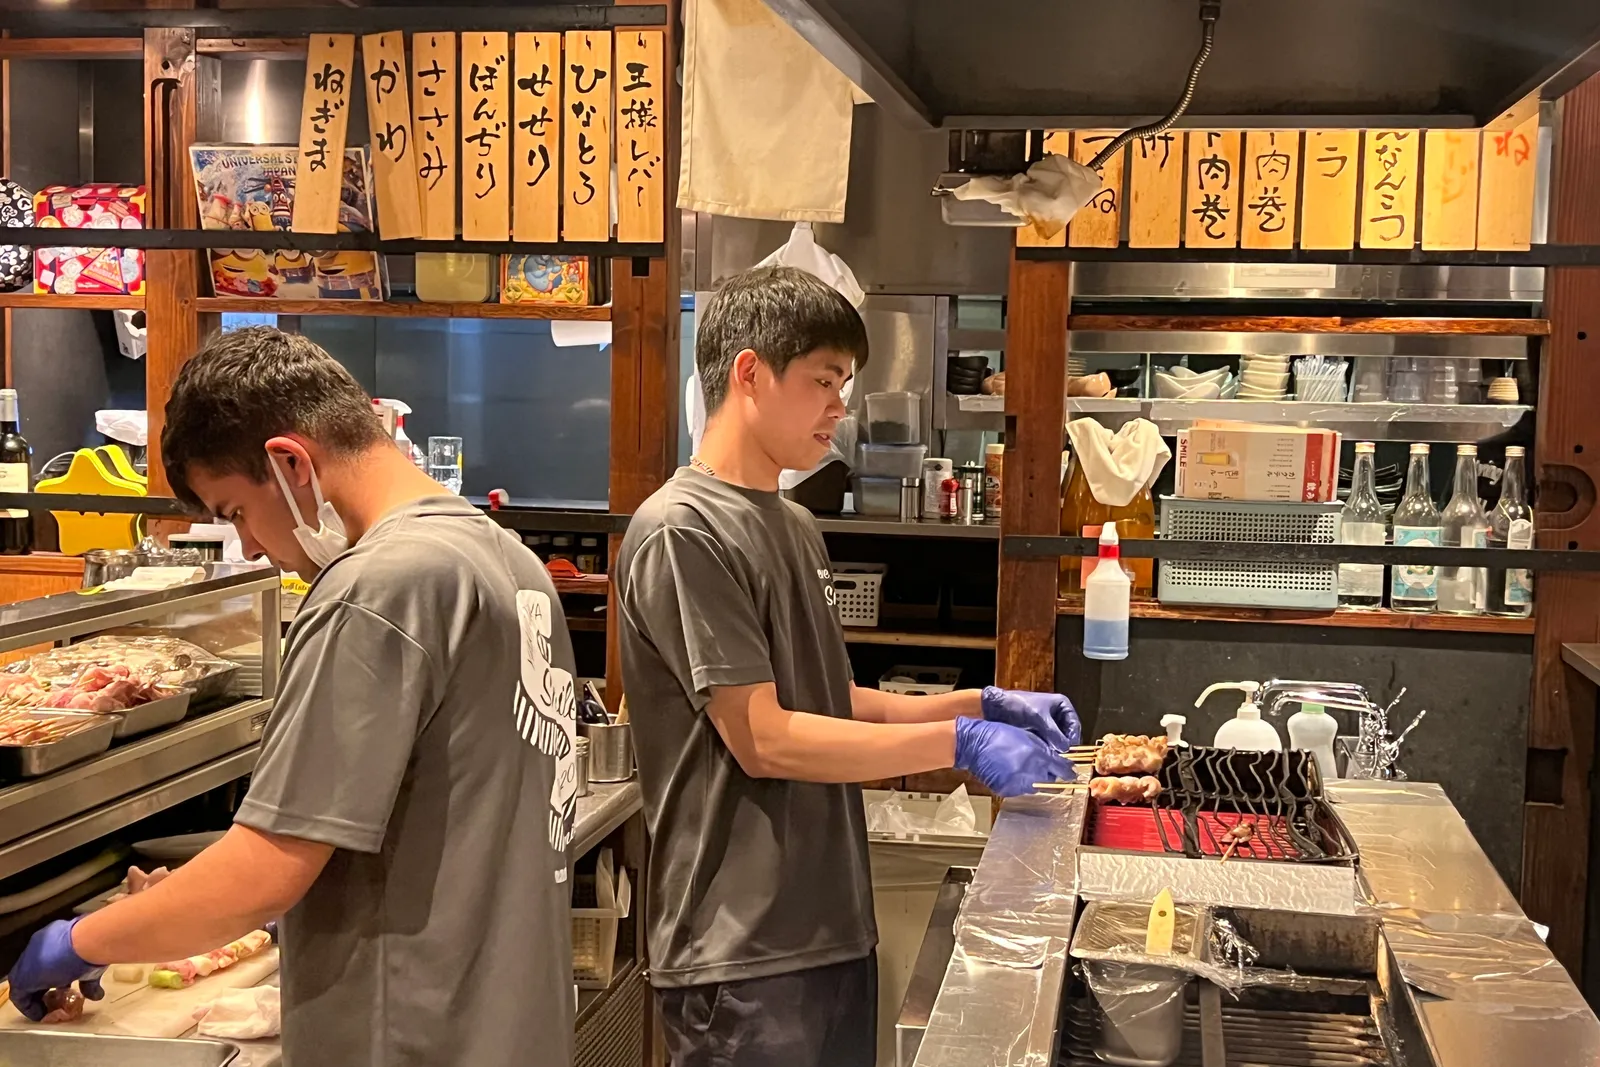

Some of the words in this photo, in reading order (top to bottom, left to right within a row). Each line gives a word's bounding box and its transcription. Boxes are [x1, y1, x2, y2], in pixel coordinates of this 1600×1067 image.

[222, 153, 284, 169] UNIVERSAL
[305, 62, 344, 172] ねぎま
[370, 59, 406, 163] かわ
[418, 59, 449, 191] ささみ
[517, 63, 553, 187] せせり
[570, 63, 607, 205] ひなとろ
[620, 61, 661, 207] 王様レバー
[263, 166, 296, 177] JAPAN
[1179, 438, 1188, 468] SMILE
[1305, 481, 1316, 500] 飲み
